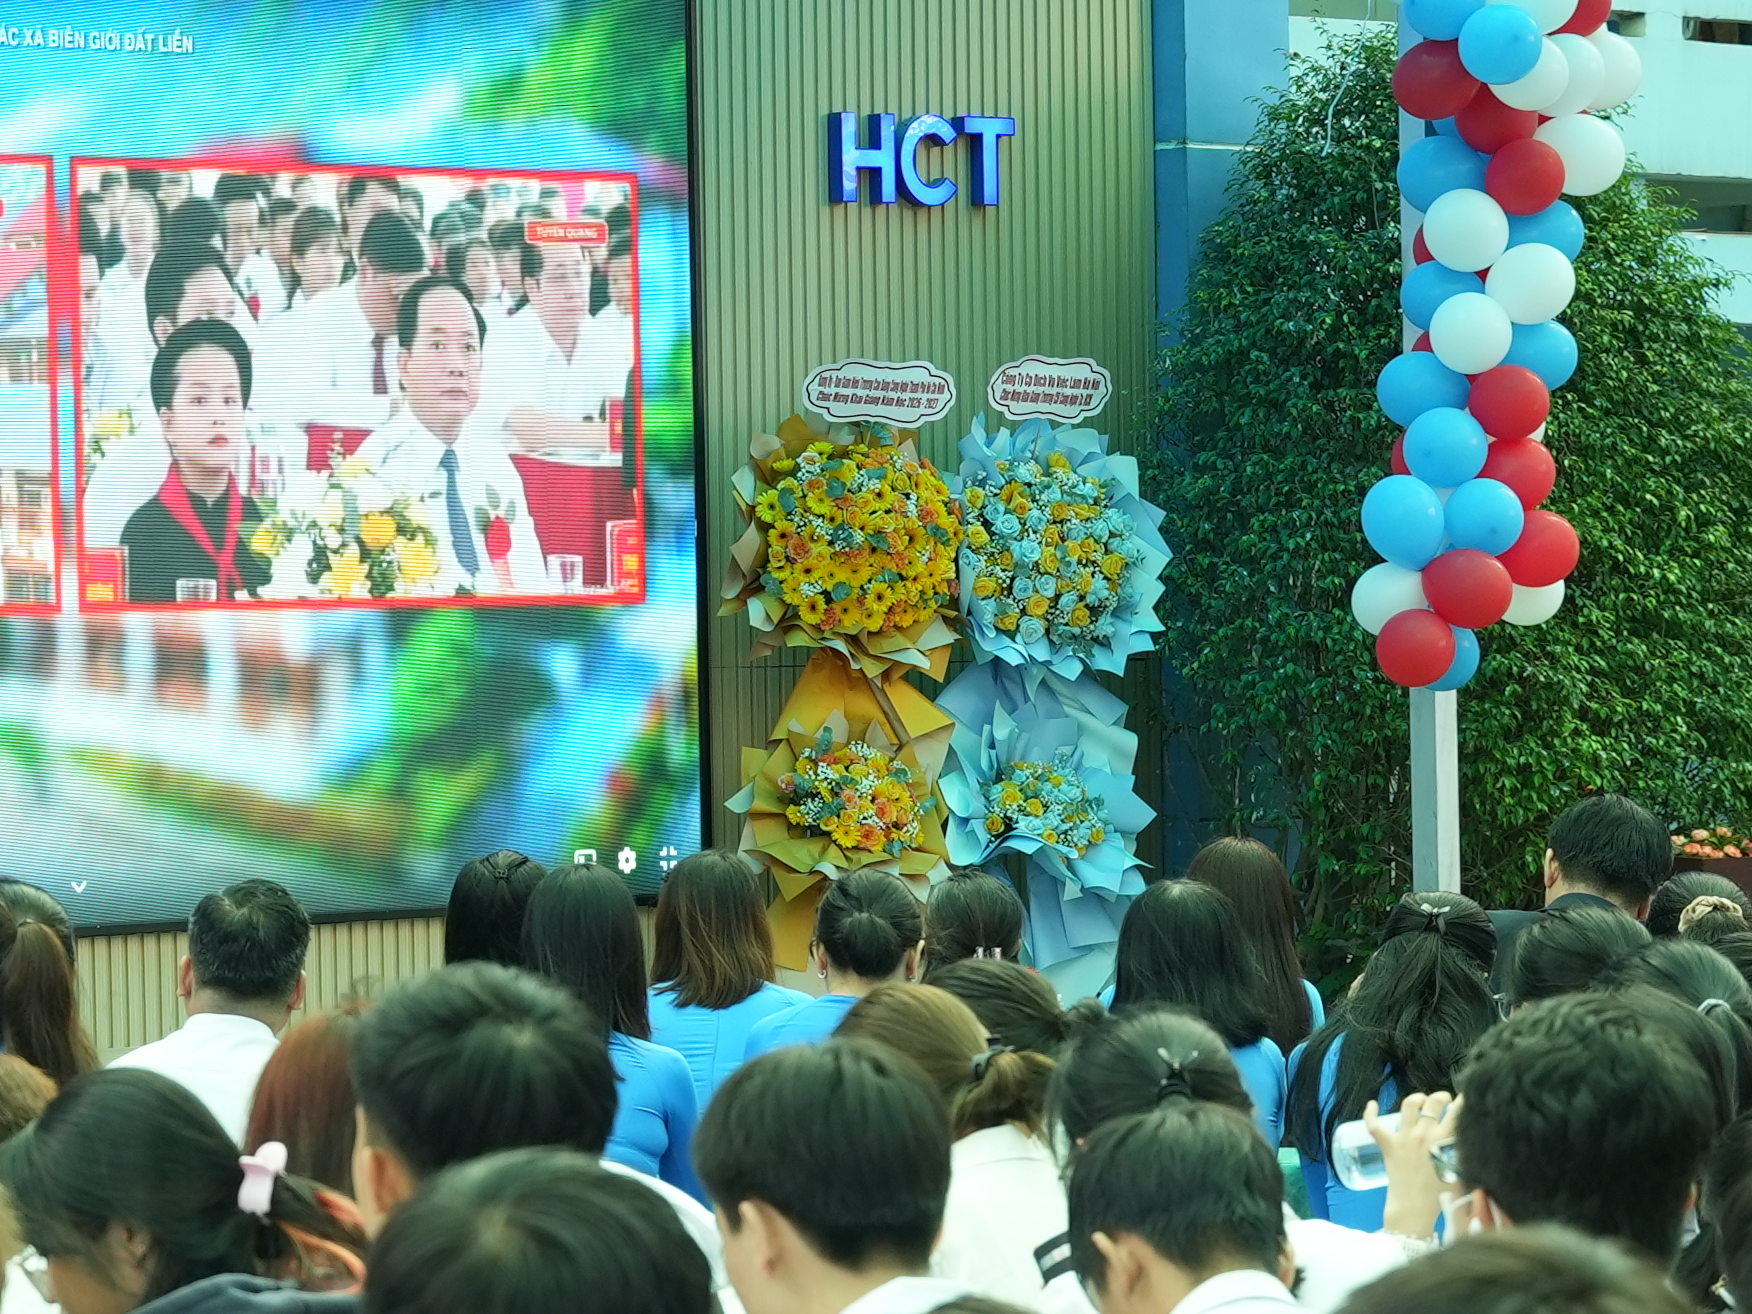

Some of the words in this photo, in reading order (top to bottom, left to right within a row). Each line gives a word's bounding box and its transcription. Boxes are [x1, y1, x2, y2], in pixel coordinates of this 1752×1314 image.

[48, 24, 85, 50] BIÊN
[124, 26, 155, 52] ĐẤT
[827, 109, 1015, 209] HCT
